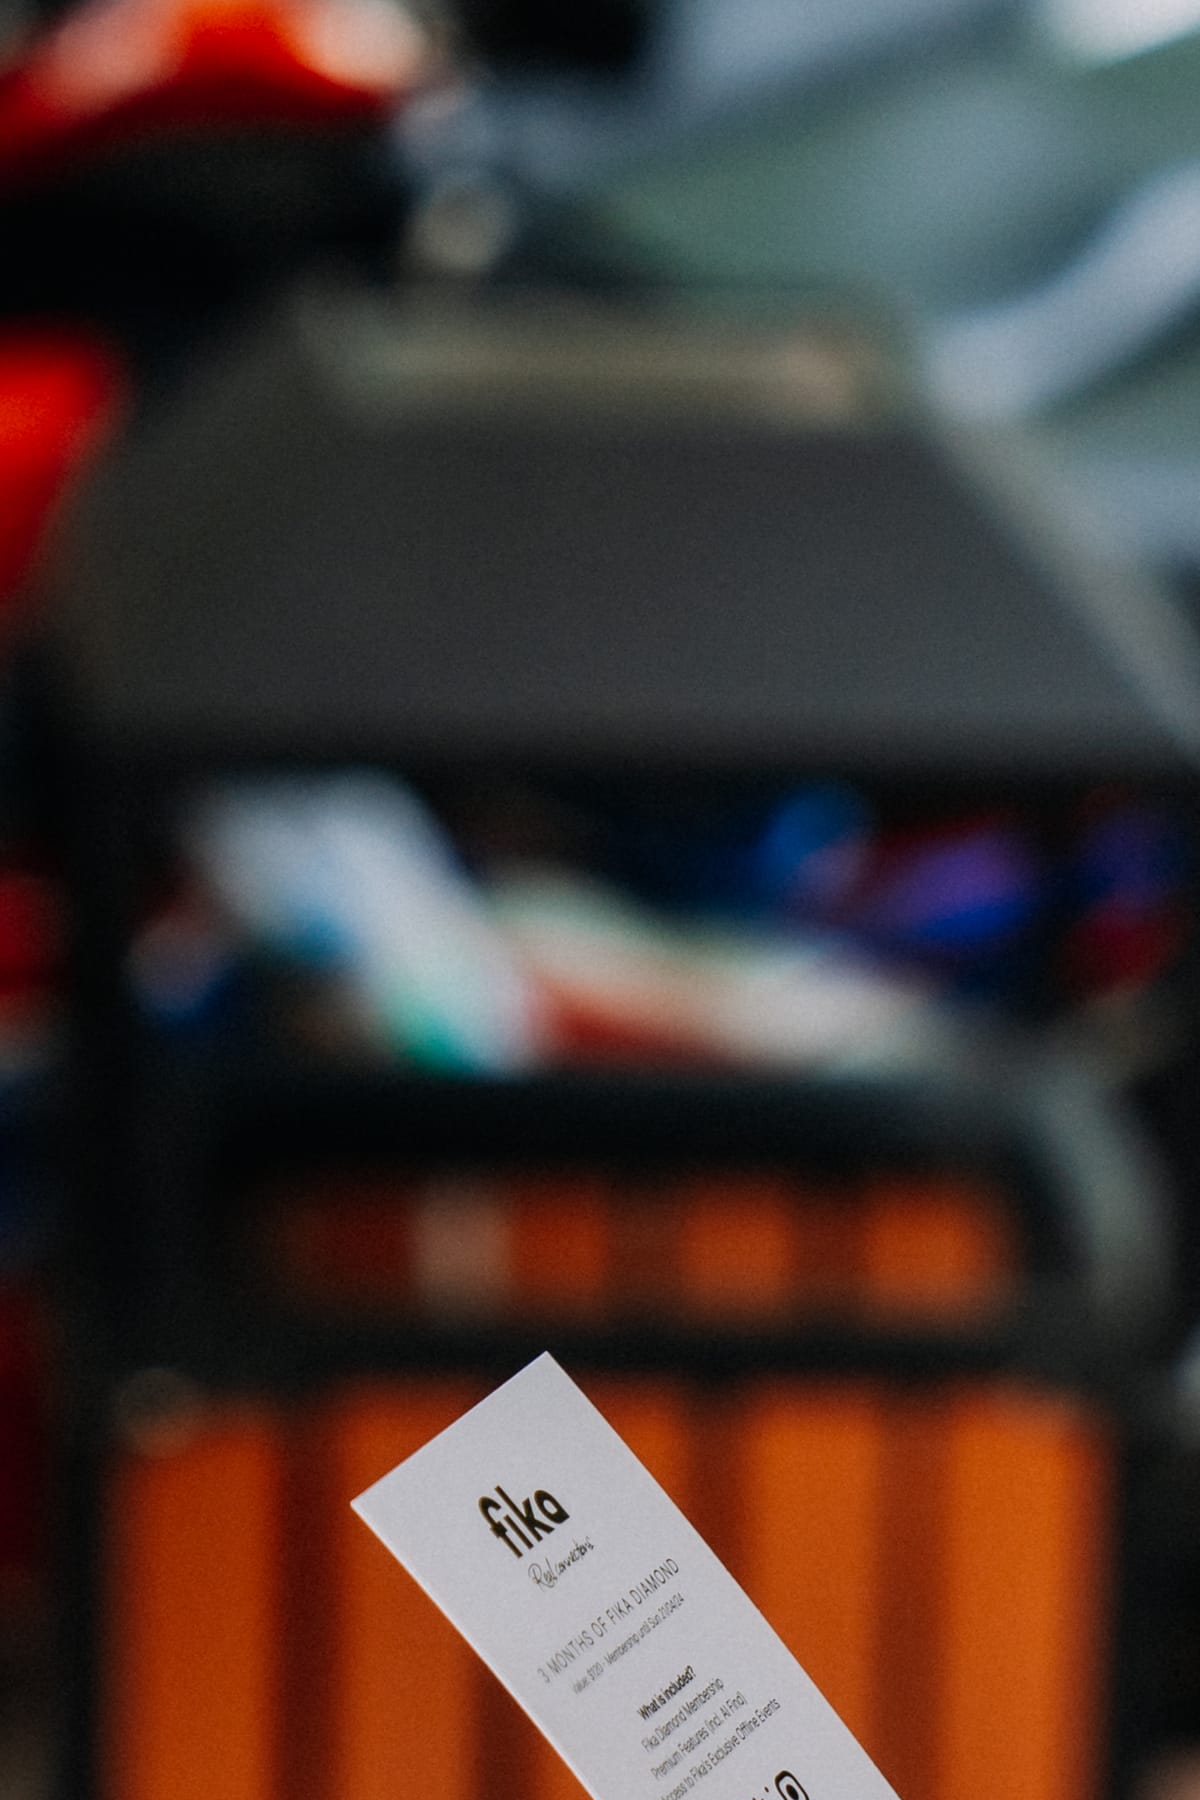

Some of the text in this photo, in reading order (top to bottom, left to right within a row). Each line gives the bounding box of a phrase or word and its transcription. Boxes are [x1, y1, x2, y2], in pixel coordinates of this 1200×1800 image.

[479, 1486, 570, 1558] fika
[537, 1559, 679, 1684] 3 MONTHS OF FIKA DIAMOND
[603, 1633, 640, 1665] Membership
[637, 1699, 661, 1720] What
[661, 1666, 696, 1700] included?
[641, 1678, 724, 1752] Fika Diamond Membership
[651, 1751, 683, 1779] Premium
[678, 1727, 709, 1756] Features
[707, 1736, 740, 1766] Exclusive
[736, 1717, 760, 1740] Offline
[755, 1699, 780, 1723] Events
